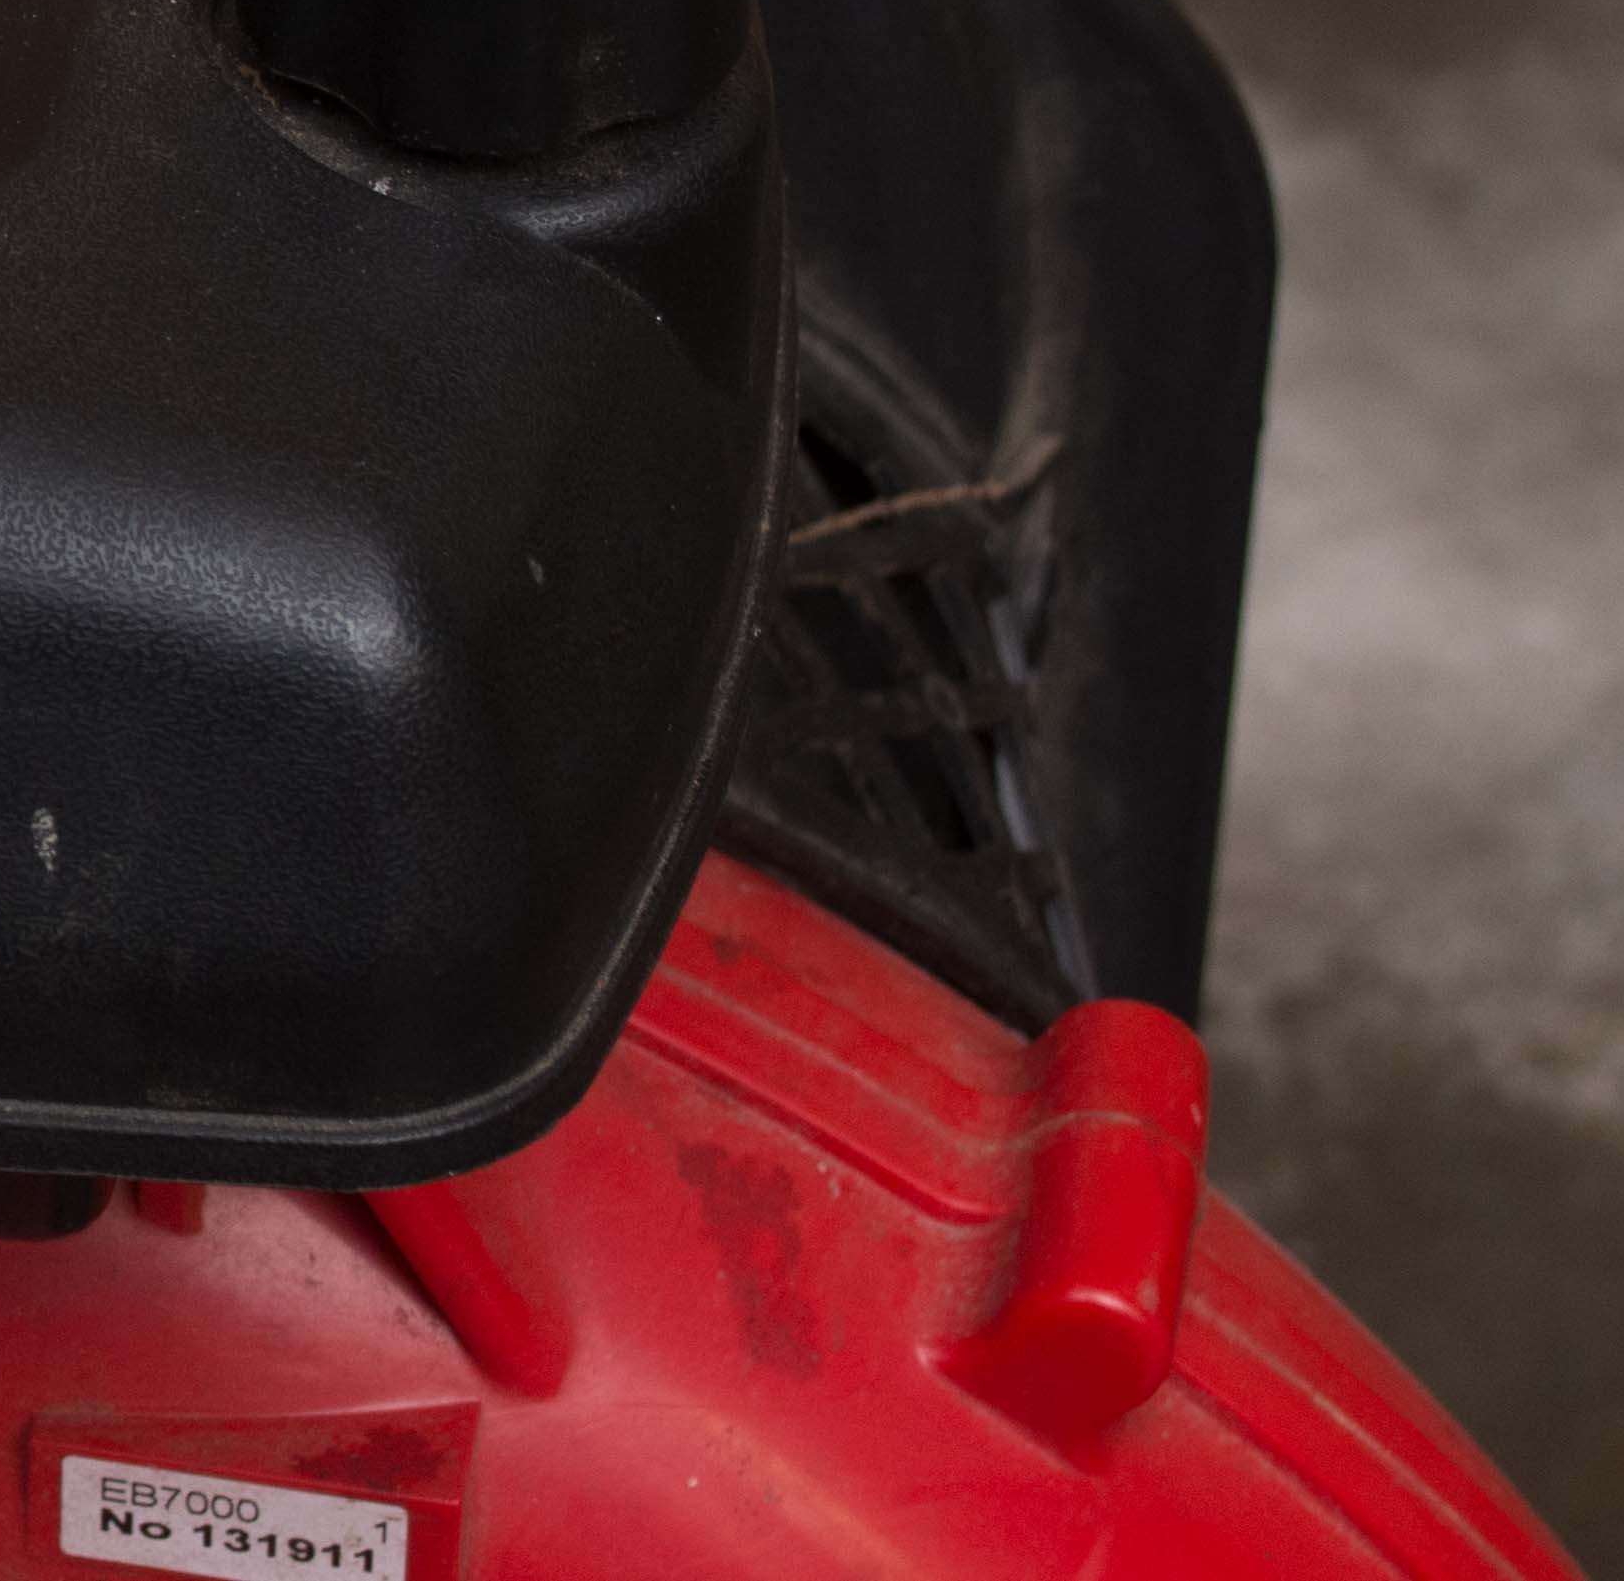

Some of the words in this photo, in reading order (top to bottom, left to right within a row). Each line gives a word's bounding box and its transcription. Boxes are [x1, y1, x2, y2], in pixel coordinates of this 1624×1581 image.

[100, 1476, 261, 1523] EB7000
[99, 1507, 172, 1541] No
[193, 1523, 375, 1573] 131911
